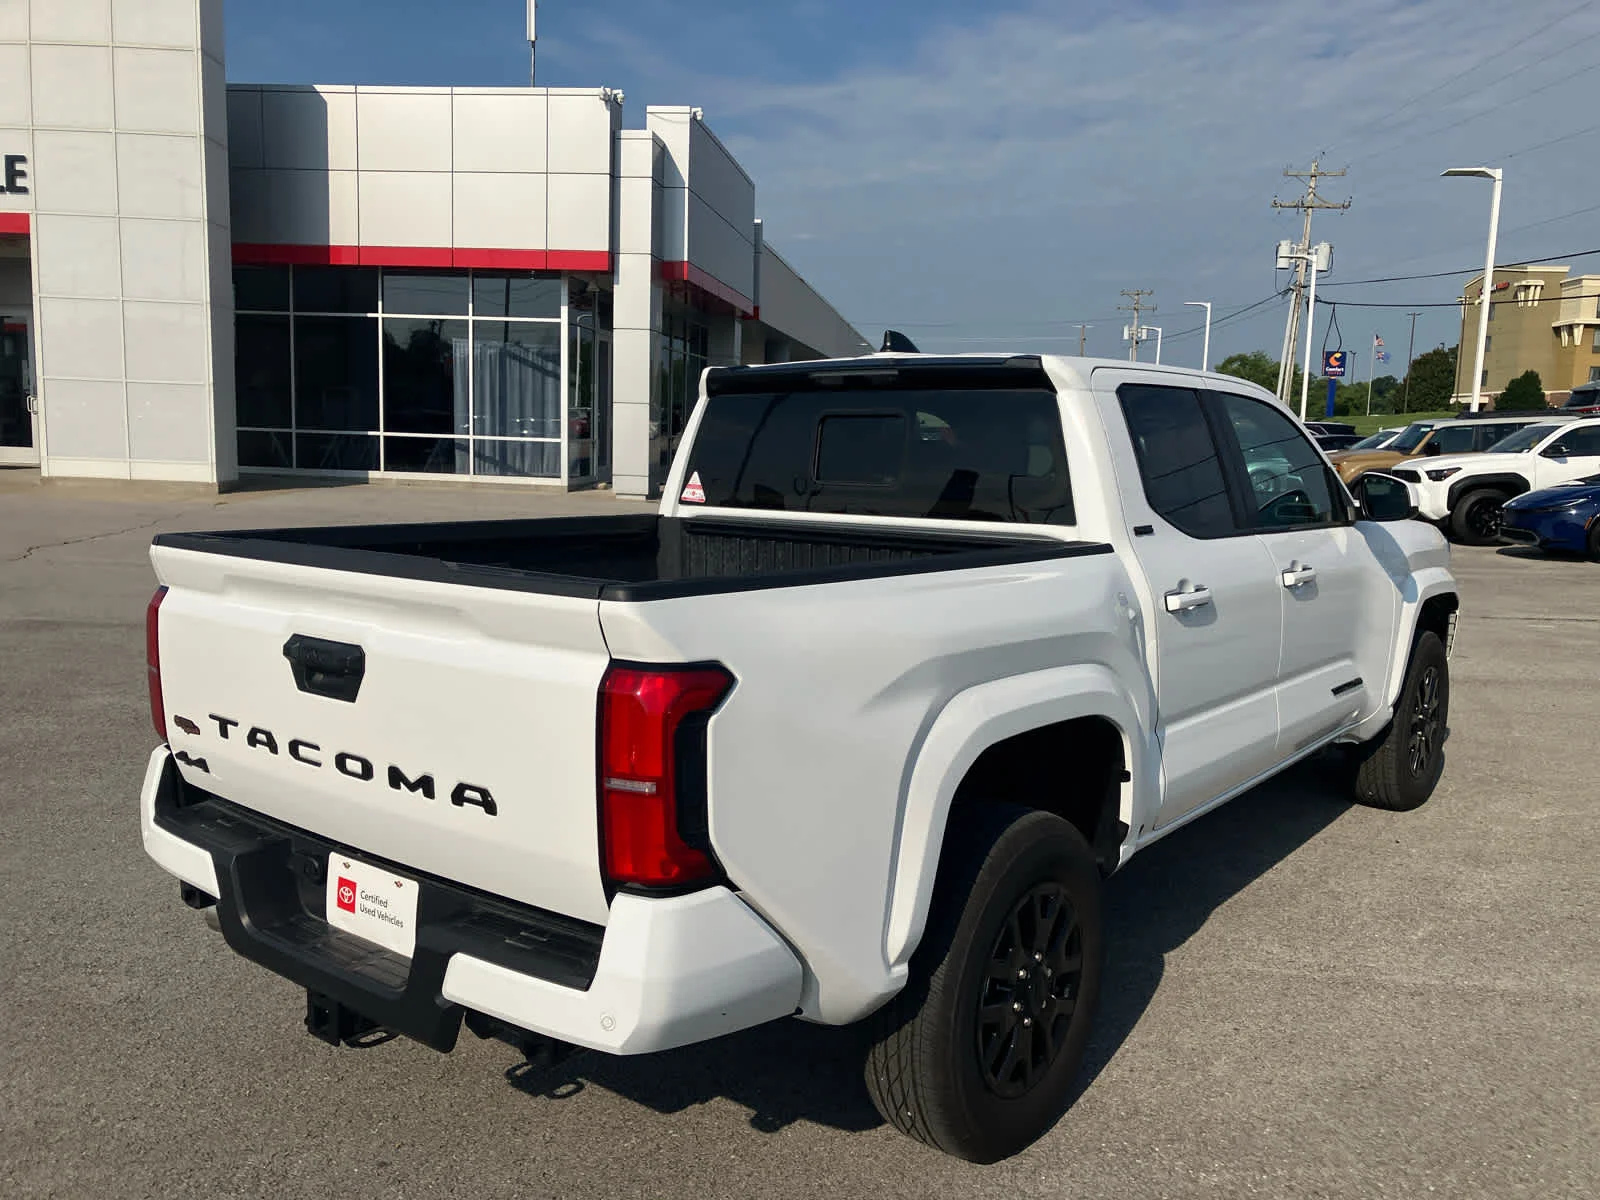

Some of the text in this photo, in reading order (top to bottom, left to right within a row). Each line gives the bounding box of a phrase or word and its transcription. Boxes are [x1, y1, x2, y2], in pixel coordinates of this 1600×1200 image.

[0, 155, 29, 195] E
[208, 713, 498, 817] TACOMA
[360, 890, 388, 908] Certified
[359, 903, 404, 928] Used Vehicles
